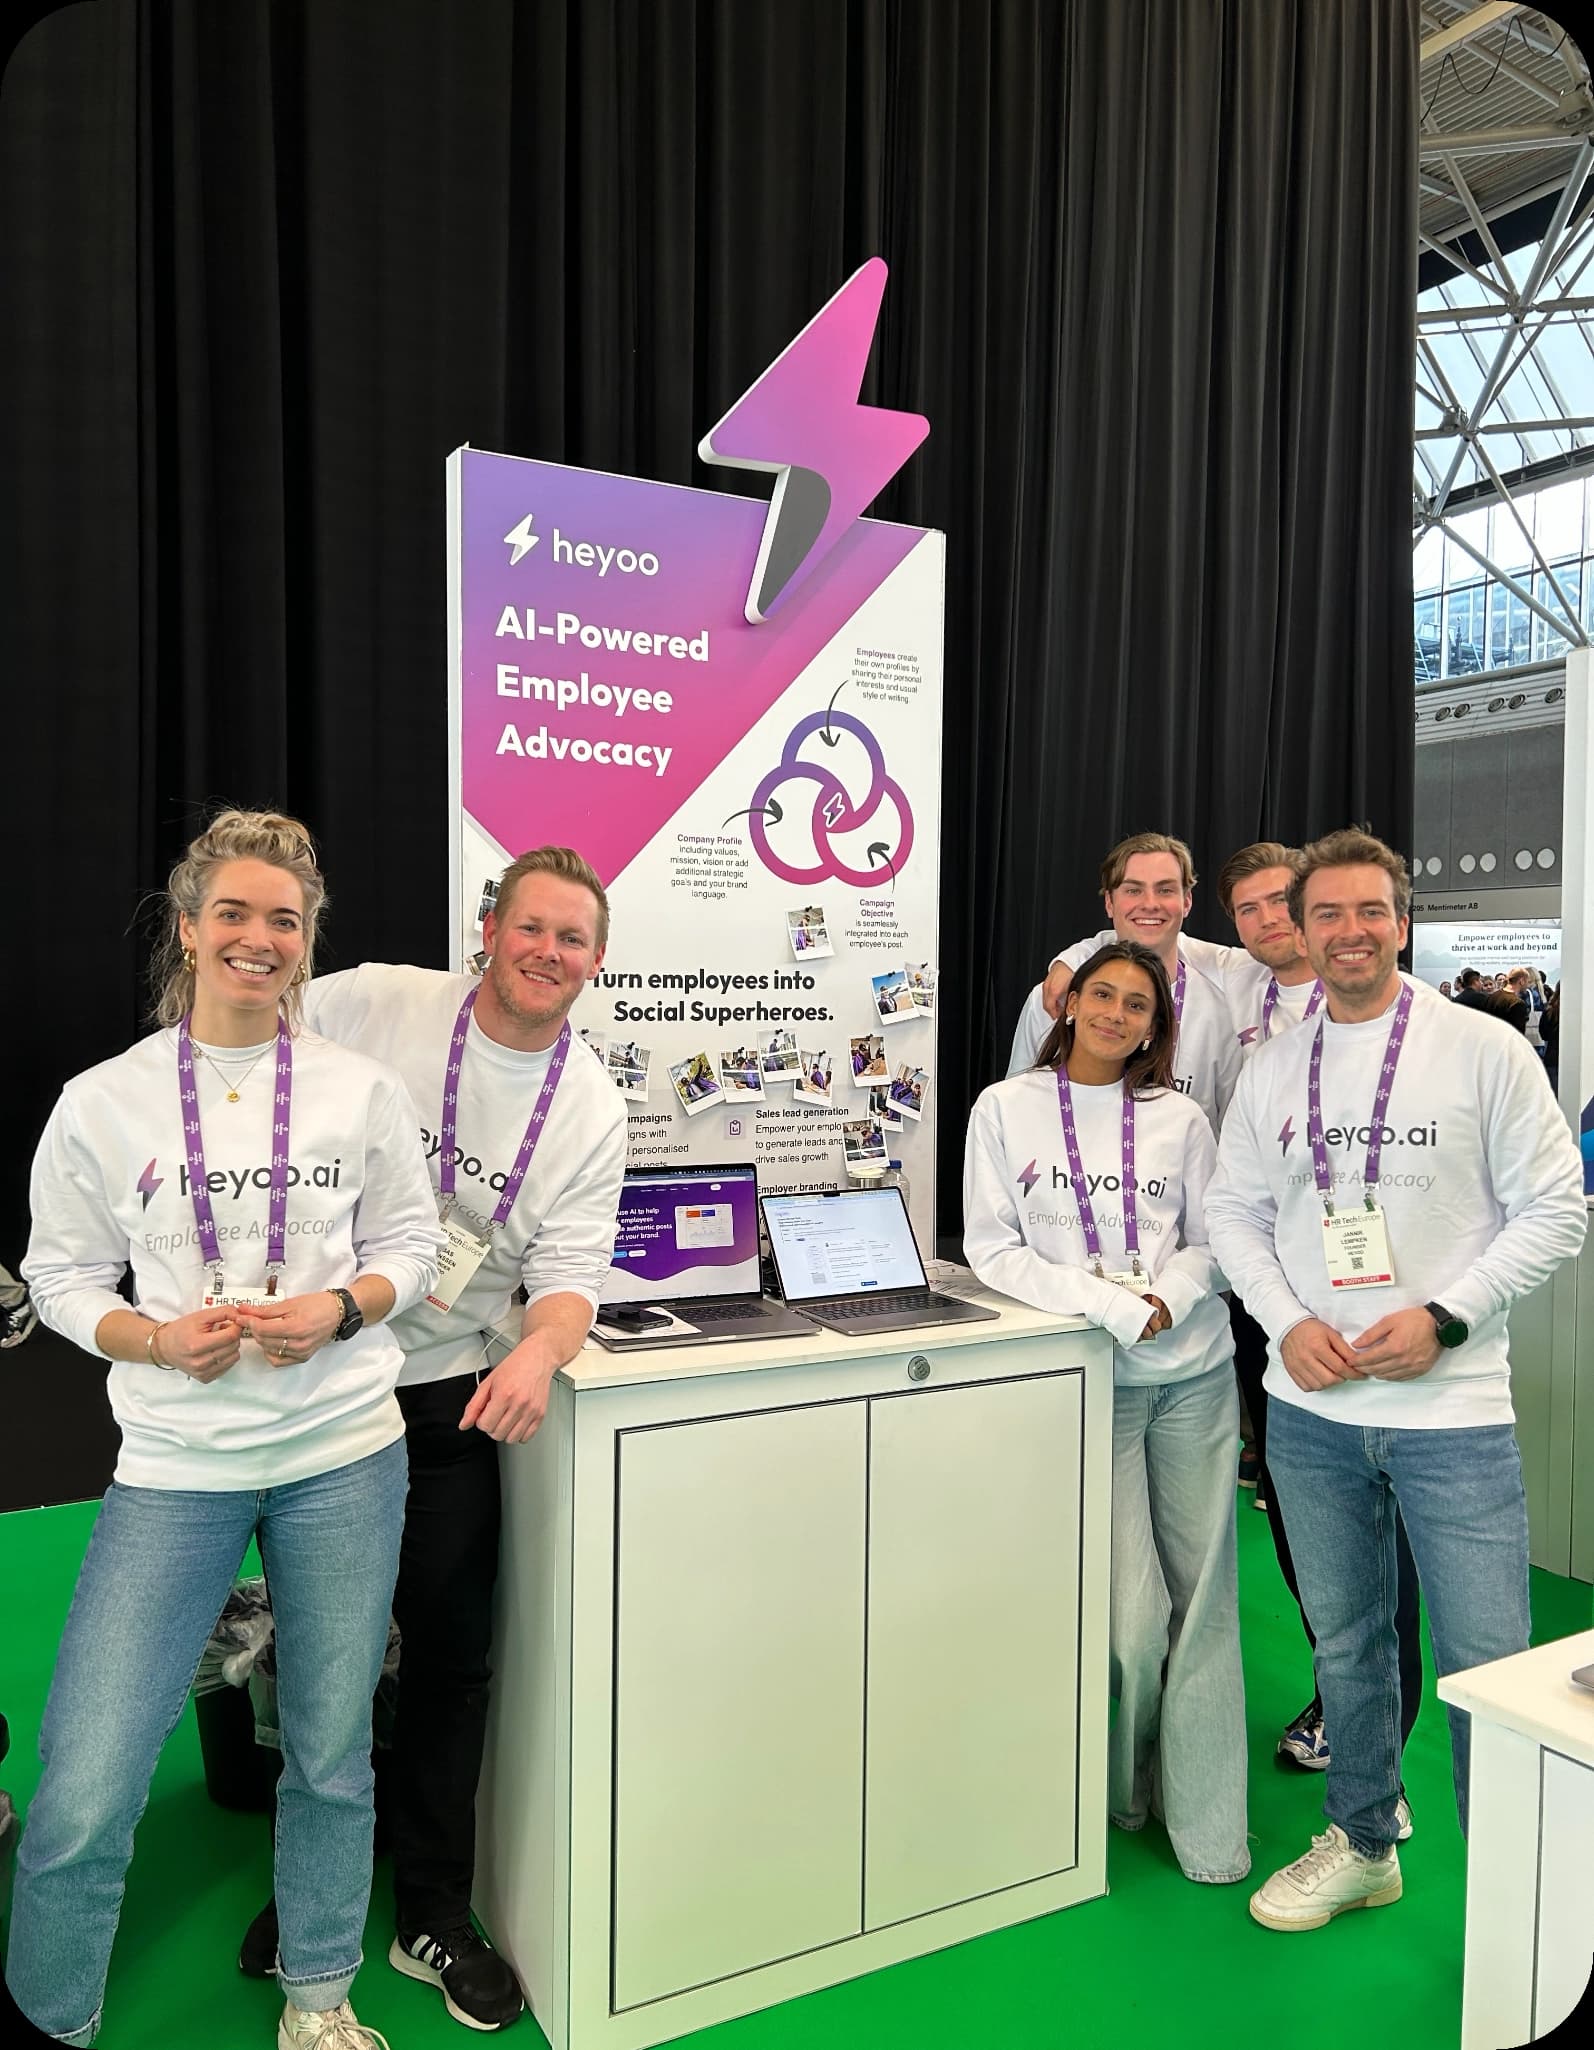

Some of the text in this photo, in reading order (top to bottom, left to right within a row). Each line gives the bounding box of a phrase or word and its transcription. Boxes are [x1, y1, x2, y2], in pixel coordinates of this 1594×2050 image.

[552, 528, 660, 577] heyoo
[495, 605, 710, 661] AI-Powered
[856, 647, 918, 662] Employees create
[854, 658, 869, 667] their
[886, 663, 910, 672] profiles
[911, 665, 920, 674] by
[851, 668, 922, 683] sharing their personal
[496, 663, 674, 717] Employee
[856, 679, 918, 694] interests and usual
[862, 691, 879, 701] style
[887, 694, 909, 704] writing
[495, 724, 673, 776] Advocacy
[677, 834, 743, 845] Company Profile
[679, 845, 740, 857] including values,
[670, 856, 701, 866] mission,
[702, 858, 724, 866] vision
[735, 859, 749, 867] add
[675, 867, 744, 879] additional strategic
[671, 878, 748, 889] goals and your brand
[859, 898, 895, 909] Campaign
[1427, 903, 1467, 912] Mentimeter
[1468, 902, 1479, 910] AB
[860, 909, 894, 918] Objective
[862, 920, 899, 930] seamlessly
[845, 929, 878, 939] integrated
[1458, 934, 1494, 942] Empower
[1497, 933, 1540, 942] employees
[1451, 944, 1476, 952] thrive
[1487, 943, 1507, 951] work
[1527, 942, 1557, 952] beyond
[593, 968, 815, 994] Turn employees into
[613, 1000, 834, 1026] Social Superheroes.
[628, 1113, 672, 1125] mpaigns
[755, 1107, 849, 1119] Sales lead generation
[649, 1129, 667, 1138] with
[755, 1122, 842, 1135] Empower your emplo
[755, 1141, 764, 1149] to
[765, 1139, 802, 1150] generate
[804, 1138, 826, 1147] leads
[632, 1144, 689, 1157] personalised
[755, 1152, 829, 1163] drive sales growth
[1052, 1166, 1167, 1199] hyo.ai
[1349, 1169, 1437, 1192] Aocacy
[757, 1182, 838, 1195] Employer branding
[1028, 1211, 1163, 1235] Employe Advcacy
[145, 1225, 241, 1254] Emploee
[216, 1297, 229, 1305] HR
